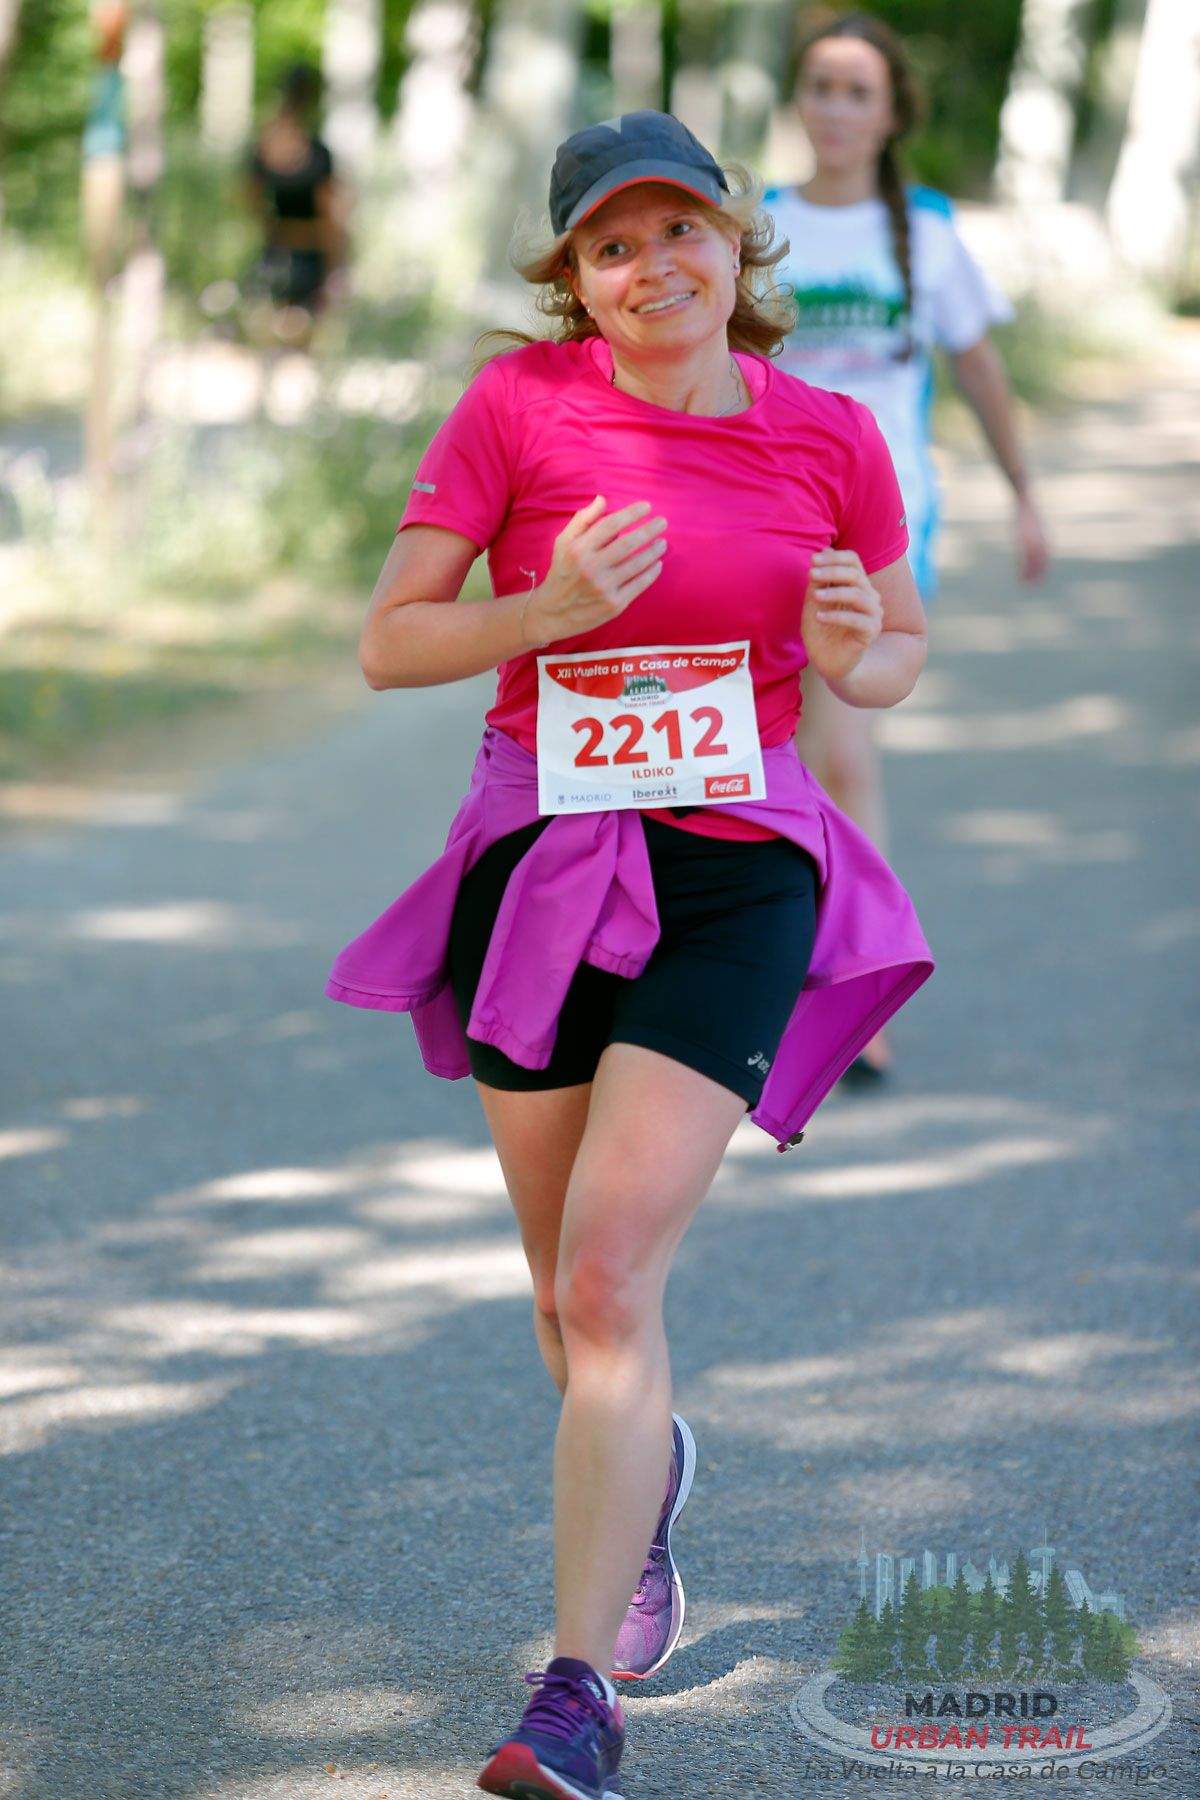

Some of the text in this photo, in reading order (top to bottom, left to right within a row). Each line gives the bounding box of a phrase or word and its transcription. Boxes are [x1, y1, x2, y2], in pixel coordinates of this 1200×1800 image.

[572, 664, 610, 678] Vuelta
[611, 665, 619, 674] a
[621, 662, 634, 673] la
[640, 660, 670, 671] Casa
[672, 657, 688, 667] de
[692, 656, 737, 668] Campo
[571, 706, 728, 767] 2212
[632, 766, 674, 779] ILDIKO
[570, 793, 612, 803] MADRID
